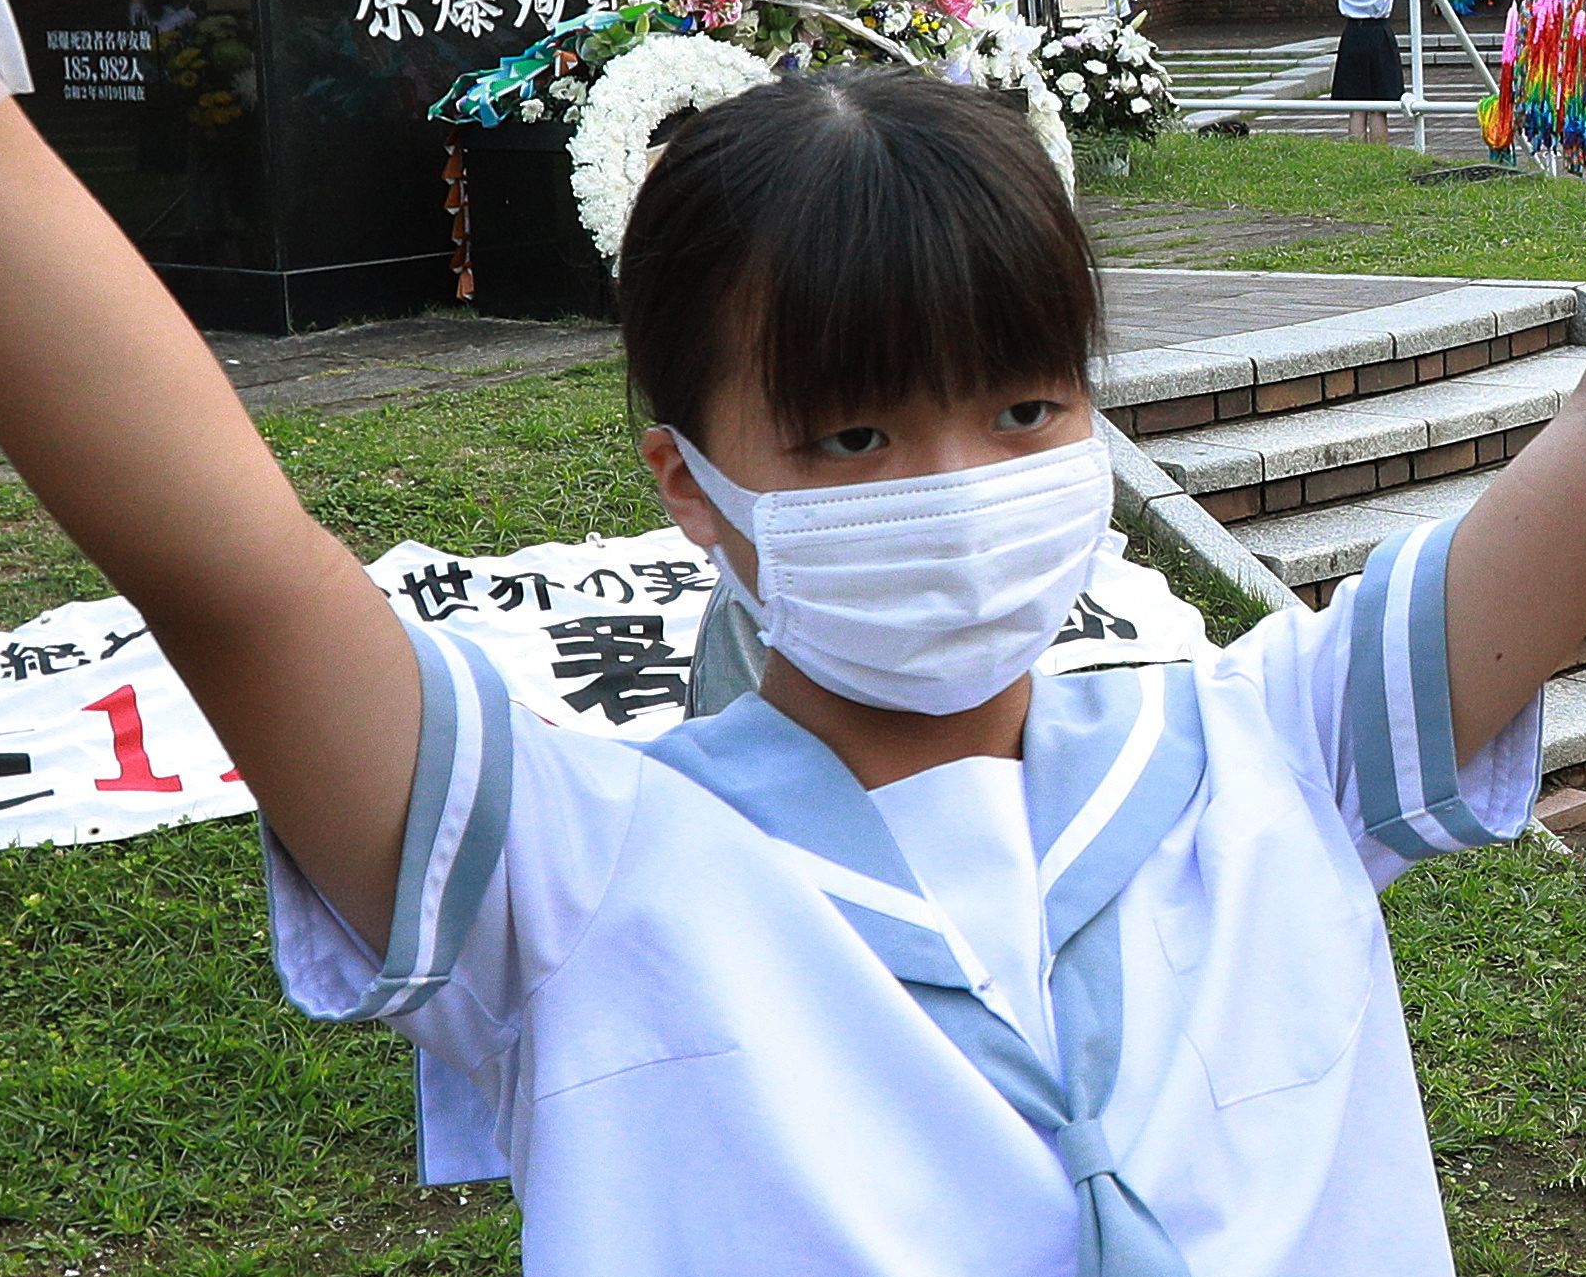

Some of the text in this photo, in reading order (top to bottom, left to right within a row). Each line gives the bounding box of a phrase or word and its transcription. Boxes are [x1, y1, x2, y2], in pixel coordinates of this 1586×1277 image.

[63, 55, 145, 83] 185,982人
[377, 559, 717, 622] 世界の実
